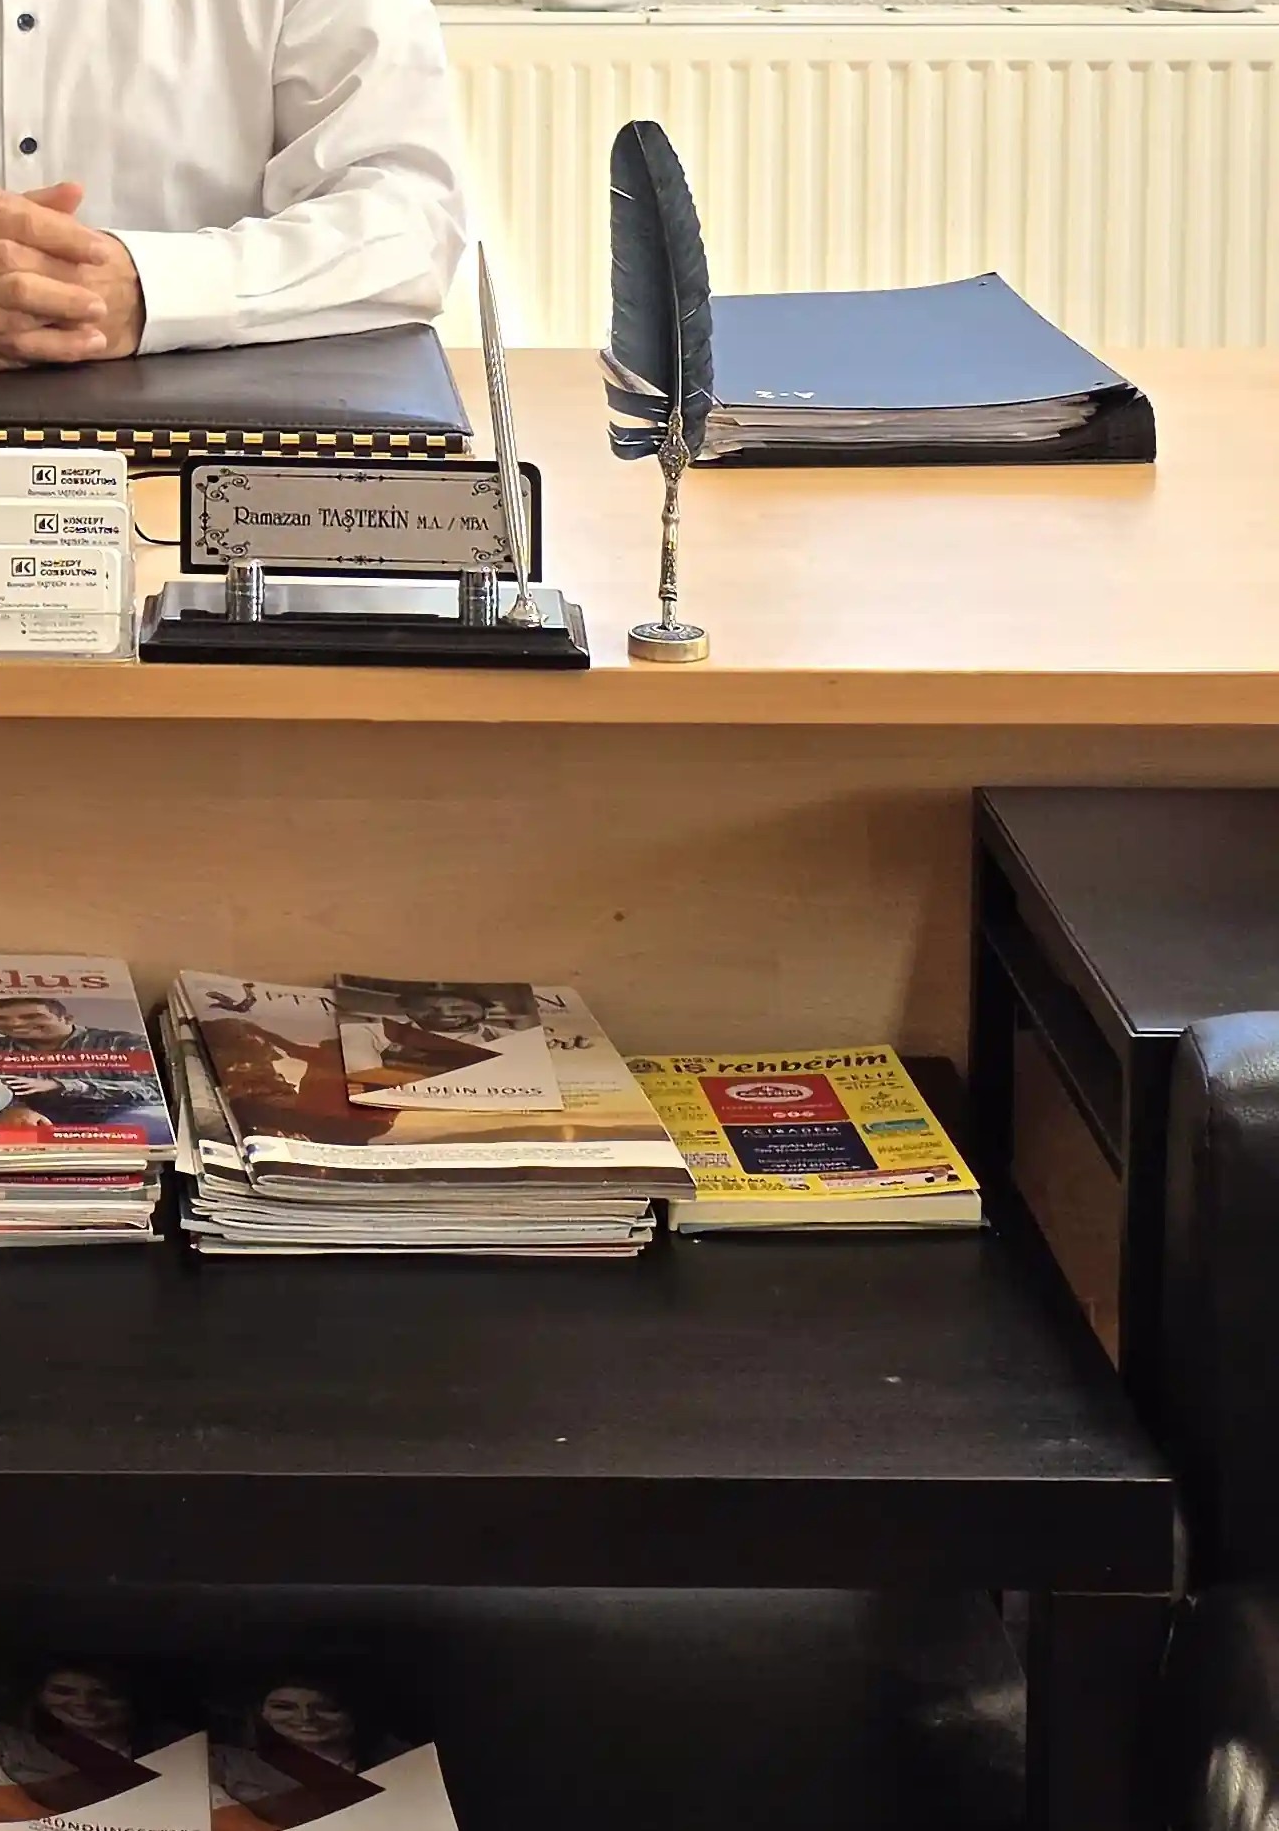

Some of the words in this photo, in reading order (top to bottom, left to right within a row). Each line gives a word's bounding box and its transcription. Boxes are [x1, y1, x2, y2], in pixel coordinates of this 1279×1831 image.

[233, 506, 311, 527] Ramazan
[318, 505, 410, 533] TAŞTEKİN
[460, 517, 490, 531] MBA
[717, 1053, 888, 1074] rehberim
